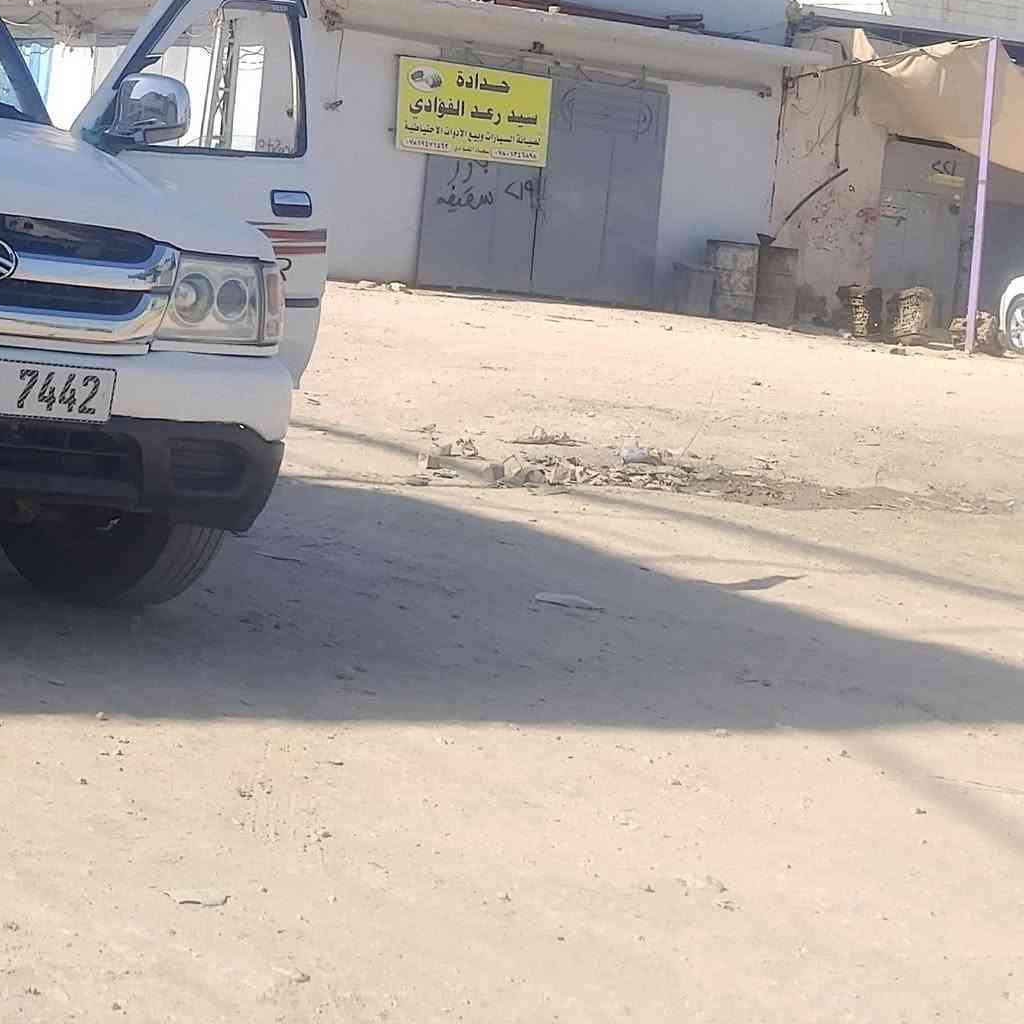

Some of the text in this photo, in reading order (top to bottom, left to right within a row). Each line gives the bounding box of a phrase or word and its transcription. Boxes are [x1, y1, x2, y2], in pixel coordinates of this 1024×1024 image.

[456, 70, 511, 94] حدادة
[470, 104, 502, 125] رعد
[508, 109, 538, 128] سيد
[17, 368, 101, 415] 7442
